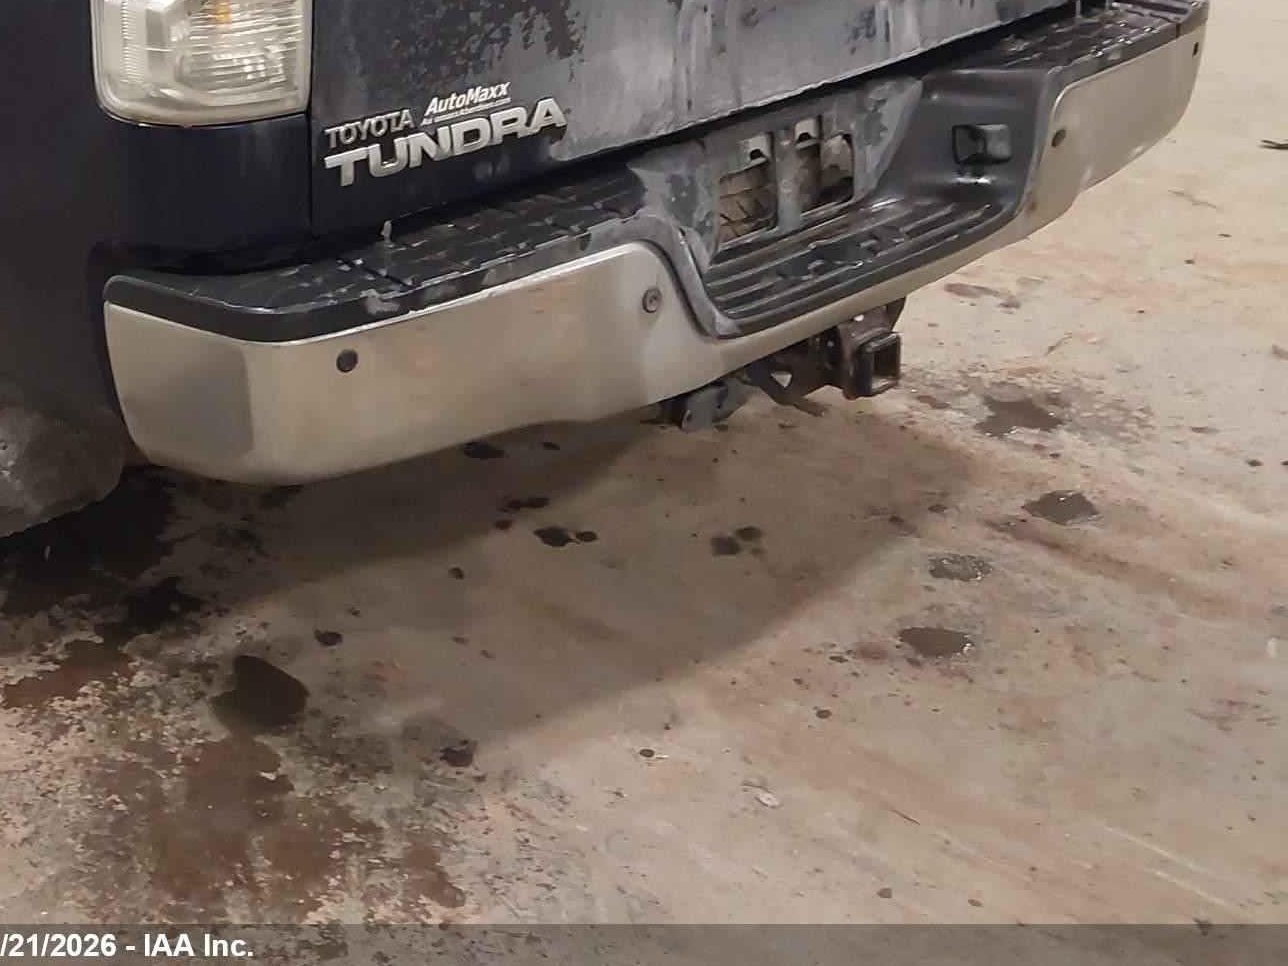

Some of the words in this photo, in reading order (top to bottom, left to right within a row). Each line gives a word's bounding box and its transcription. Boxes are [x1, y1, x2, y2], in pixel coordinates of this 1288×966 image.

[424, 82, 510, 116] AutoMaxx
[324, 109, 414, 148] TOYOTA
[324, 98, 567, 186] TUNDRA
